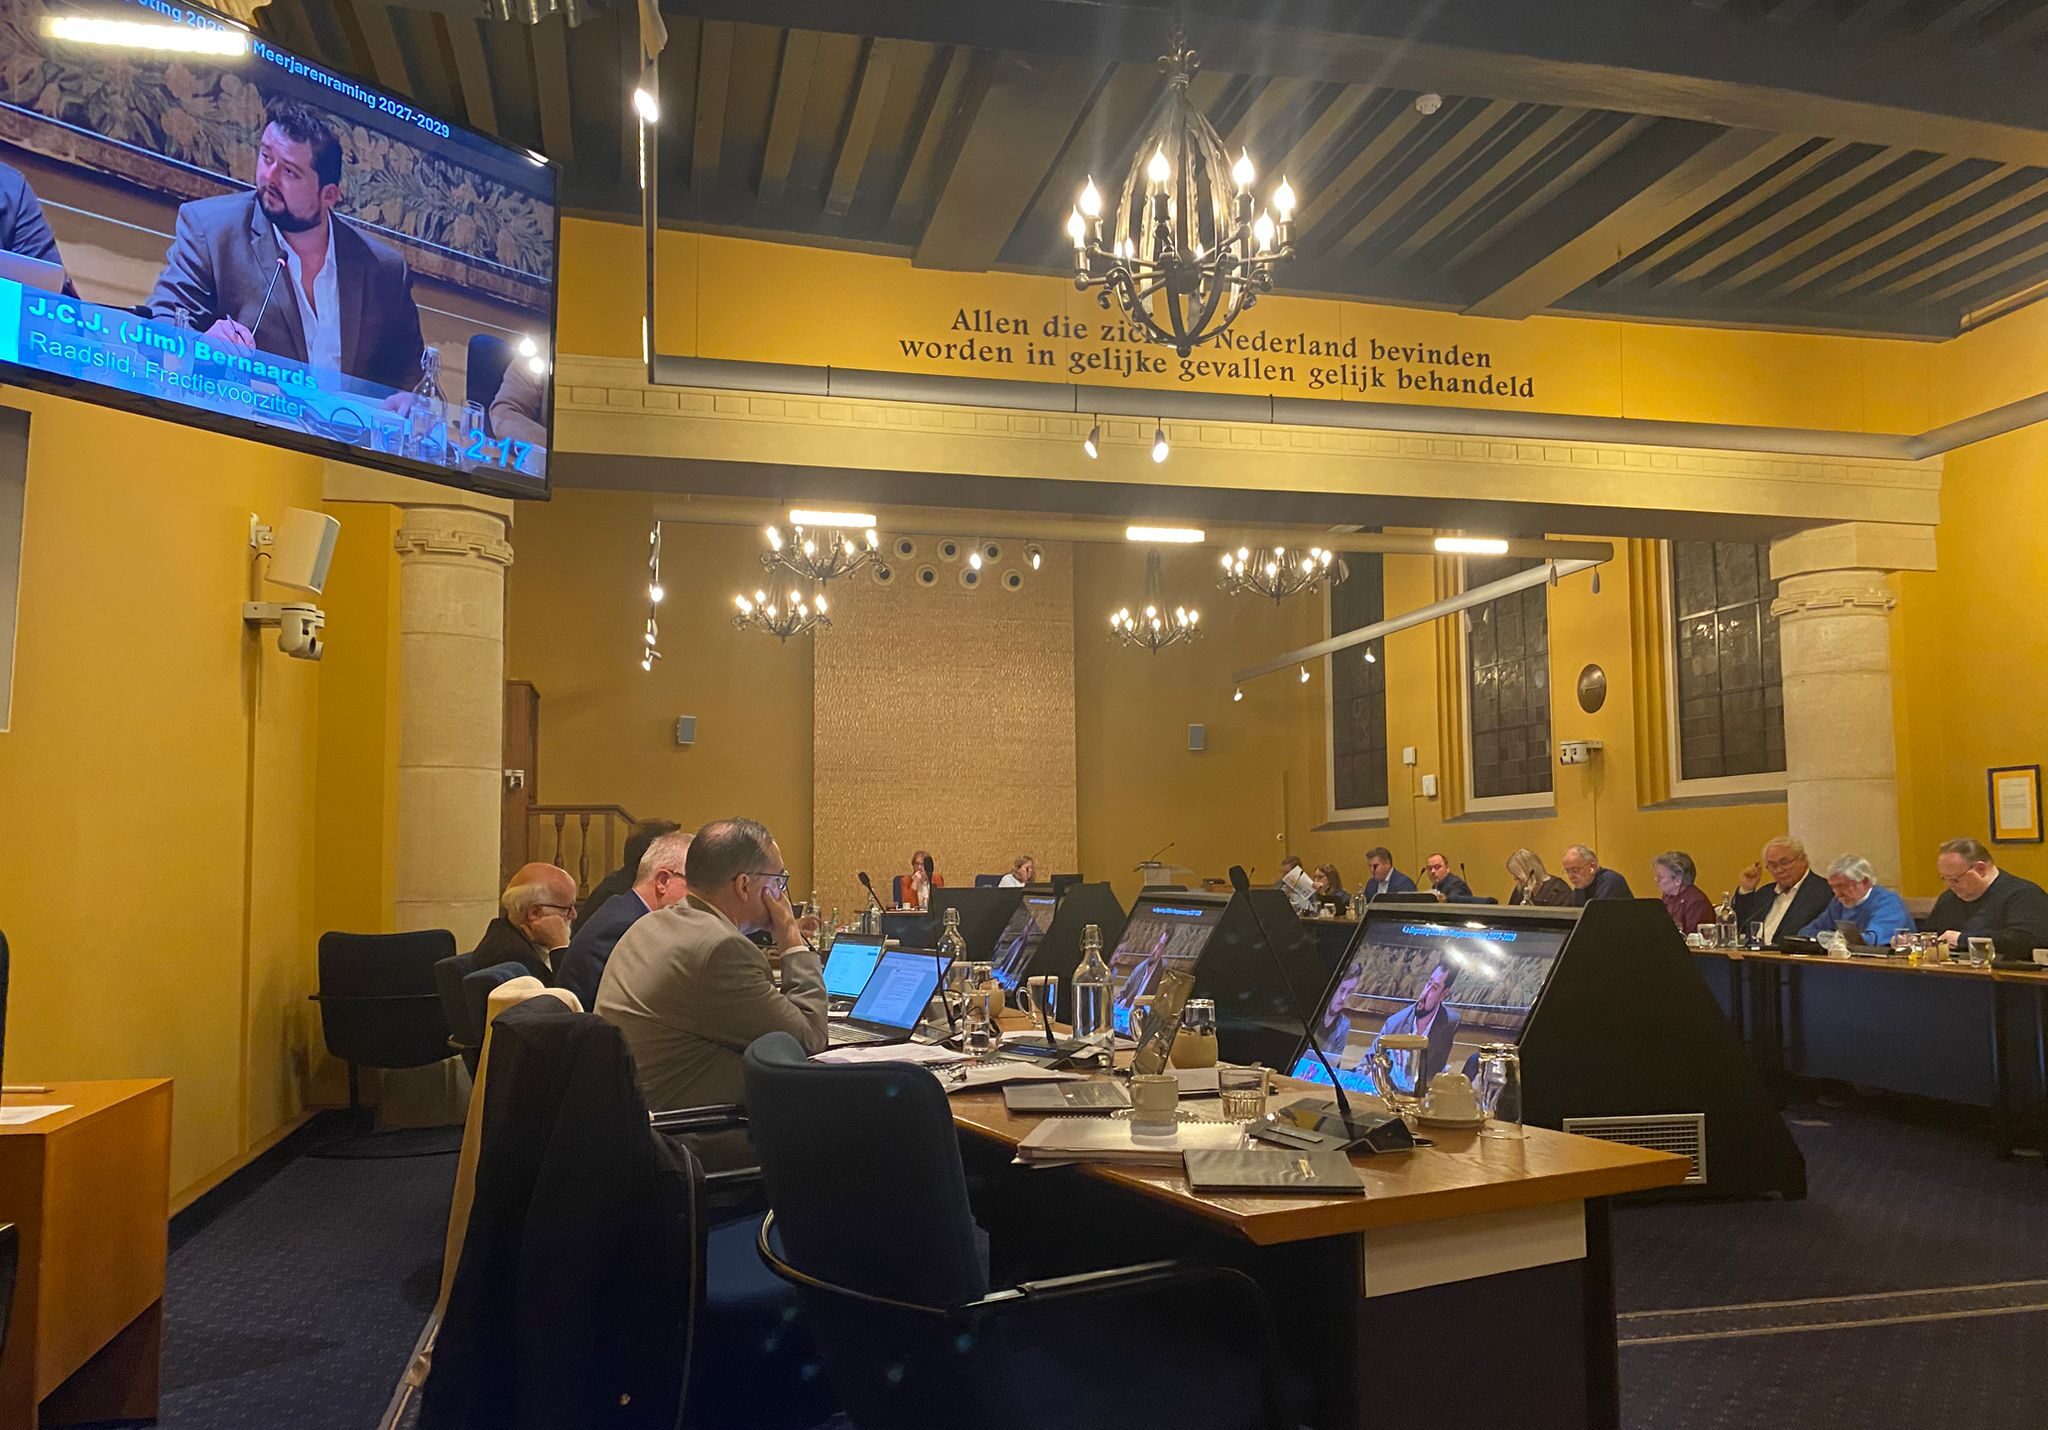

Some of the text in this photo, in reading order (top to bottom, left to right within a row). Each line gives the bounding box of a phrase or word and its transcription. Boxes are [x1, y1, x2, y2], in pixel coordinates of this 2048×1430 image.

[253, 40, 376, 109] Meerjarenraming
[378, 97, 450, 138] 2027-2029
[28, 298, 318, 389] J.C.J. (Jim) Bernaards
[29, 330, 306, 417] Raadslid, Fractievoorzitter
[899, 338, 1534, 398] worden in gelijke gevallen gelijk behandeld
[951, 308, 1030, 335] Allen
[1043, 315, 1088, 339] die
[1214, 329, 1357, 358] Nederland
[1370, 339, 1491, 368] bevinden
[466, 428, 533, 471] 2:17
